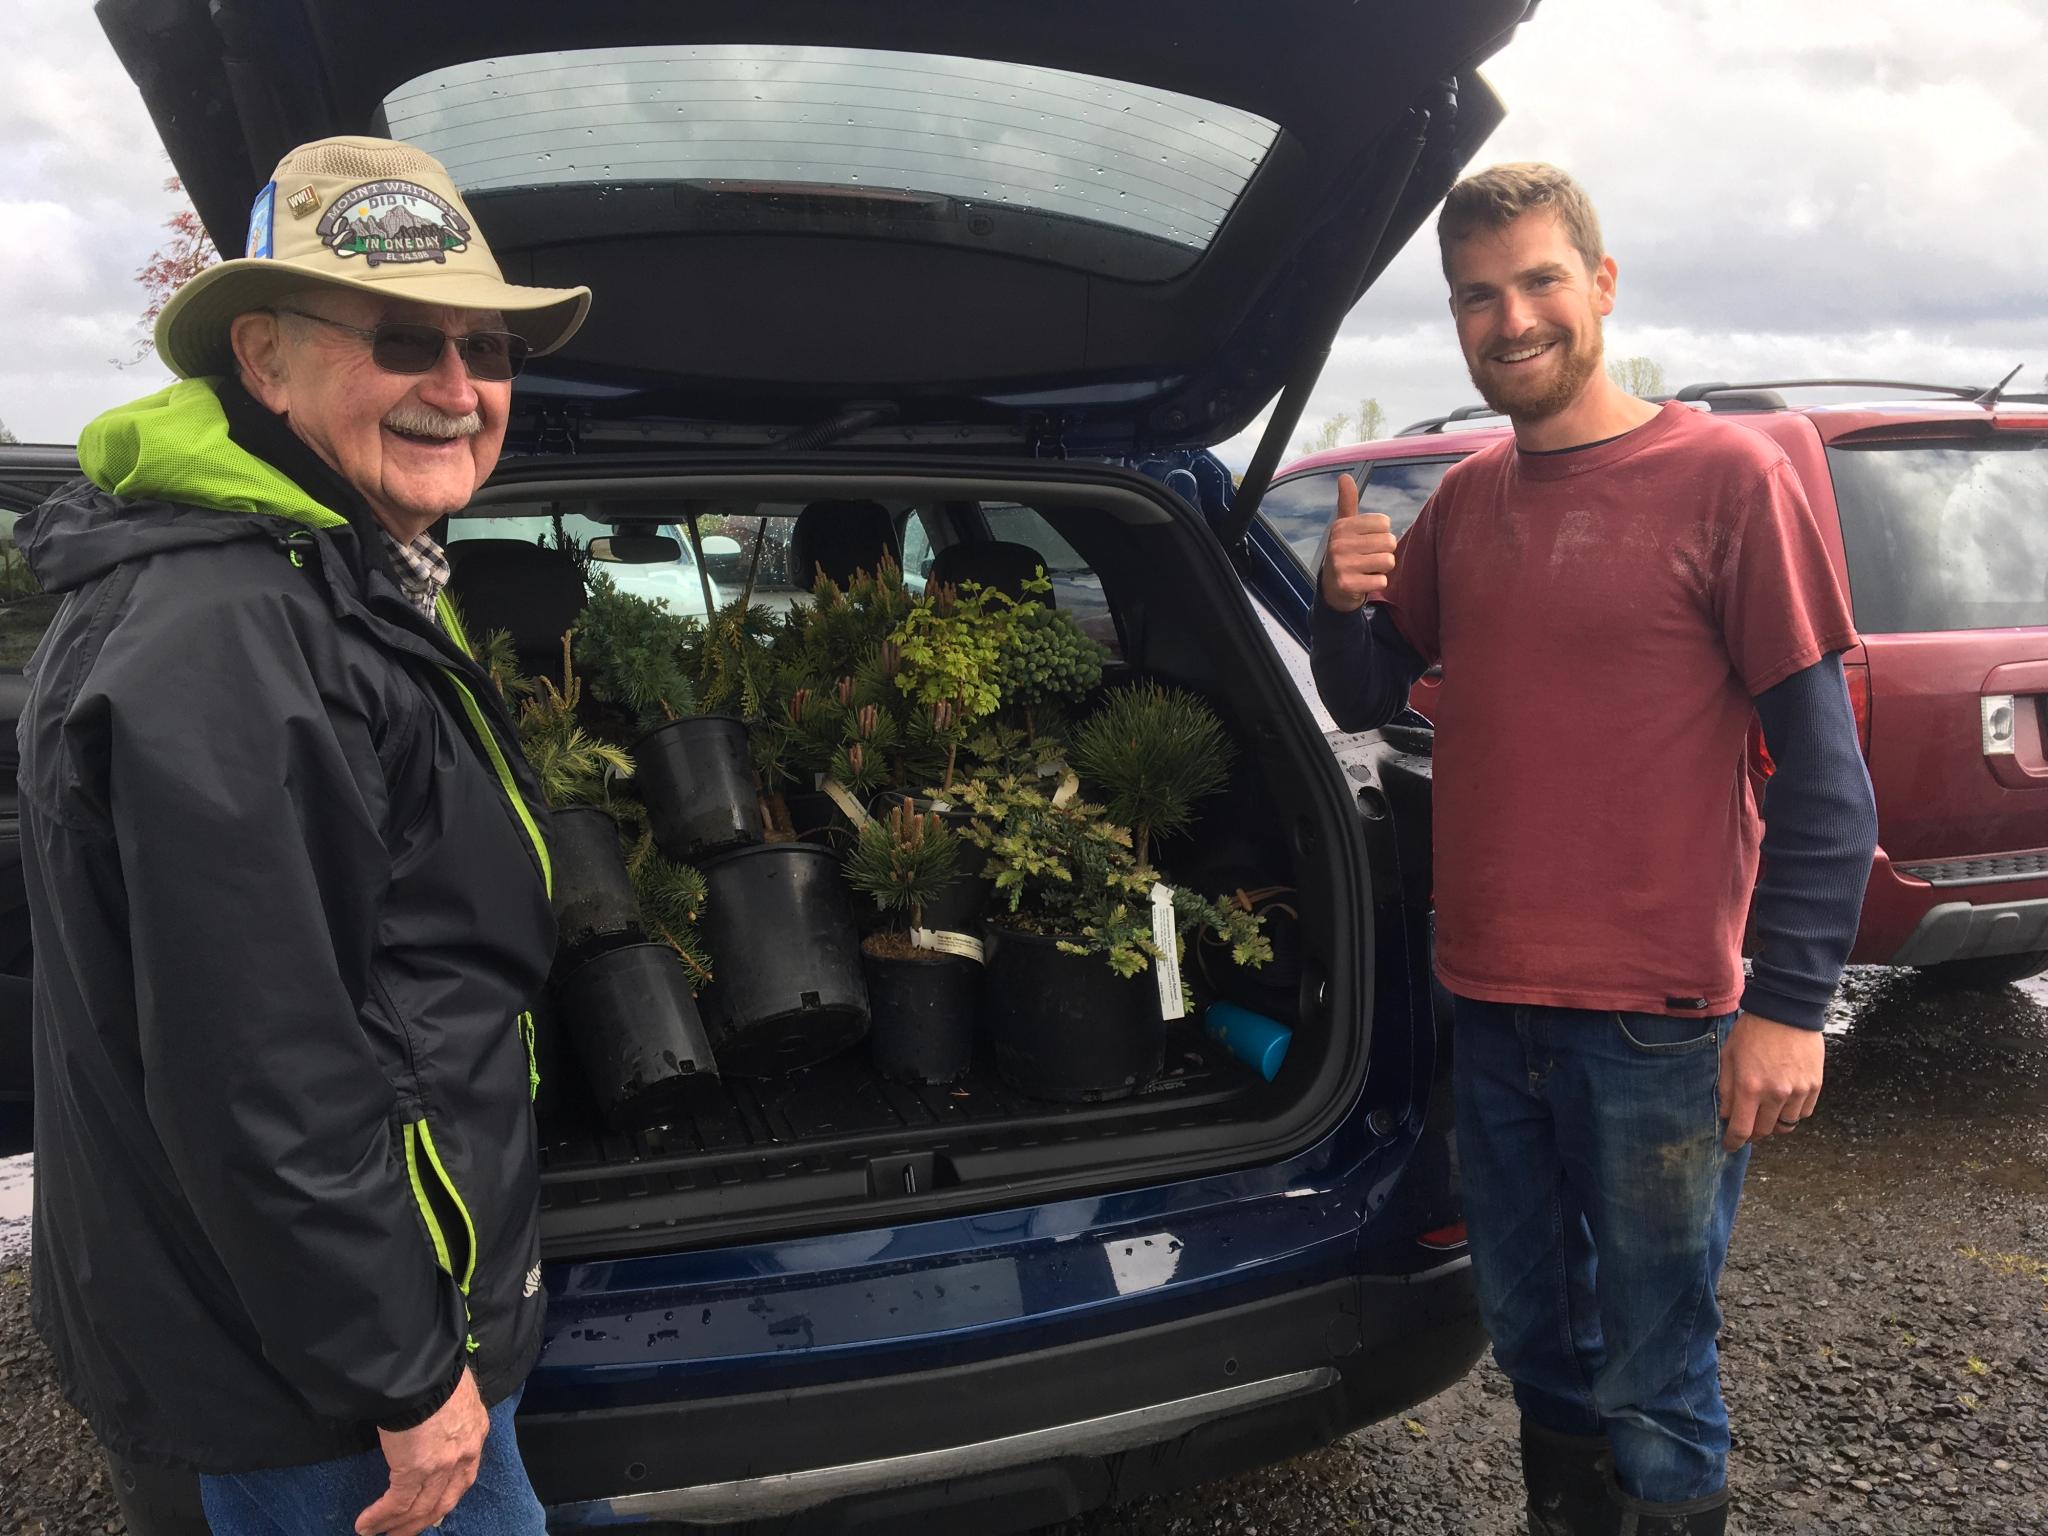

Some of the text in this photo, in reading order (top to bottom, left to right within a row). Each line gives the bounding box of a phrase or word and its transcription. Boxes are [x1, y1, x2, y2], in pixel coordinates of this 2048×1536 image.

[288, 188, 313, 208] WWII
[327, 184, 380, 220] MOUNT
[383, 181, 458, 218] WHITNEY
[368, 195, 418, 209] DID IT
[365, 235, 440, 249] IN ONE DAY
